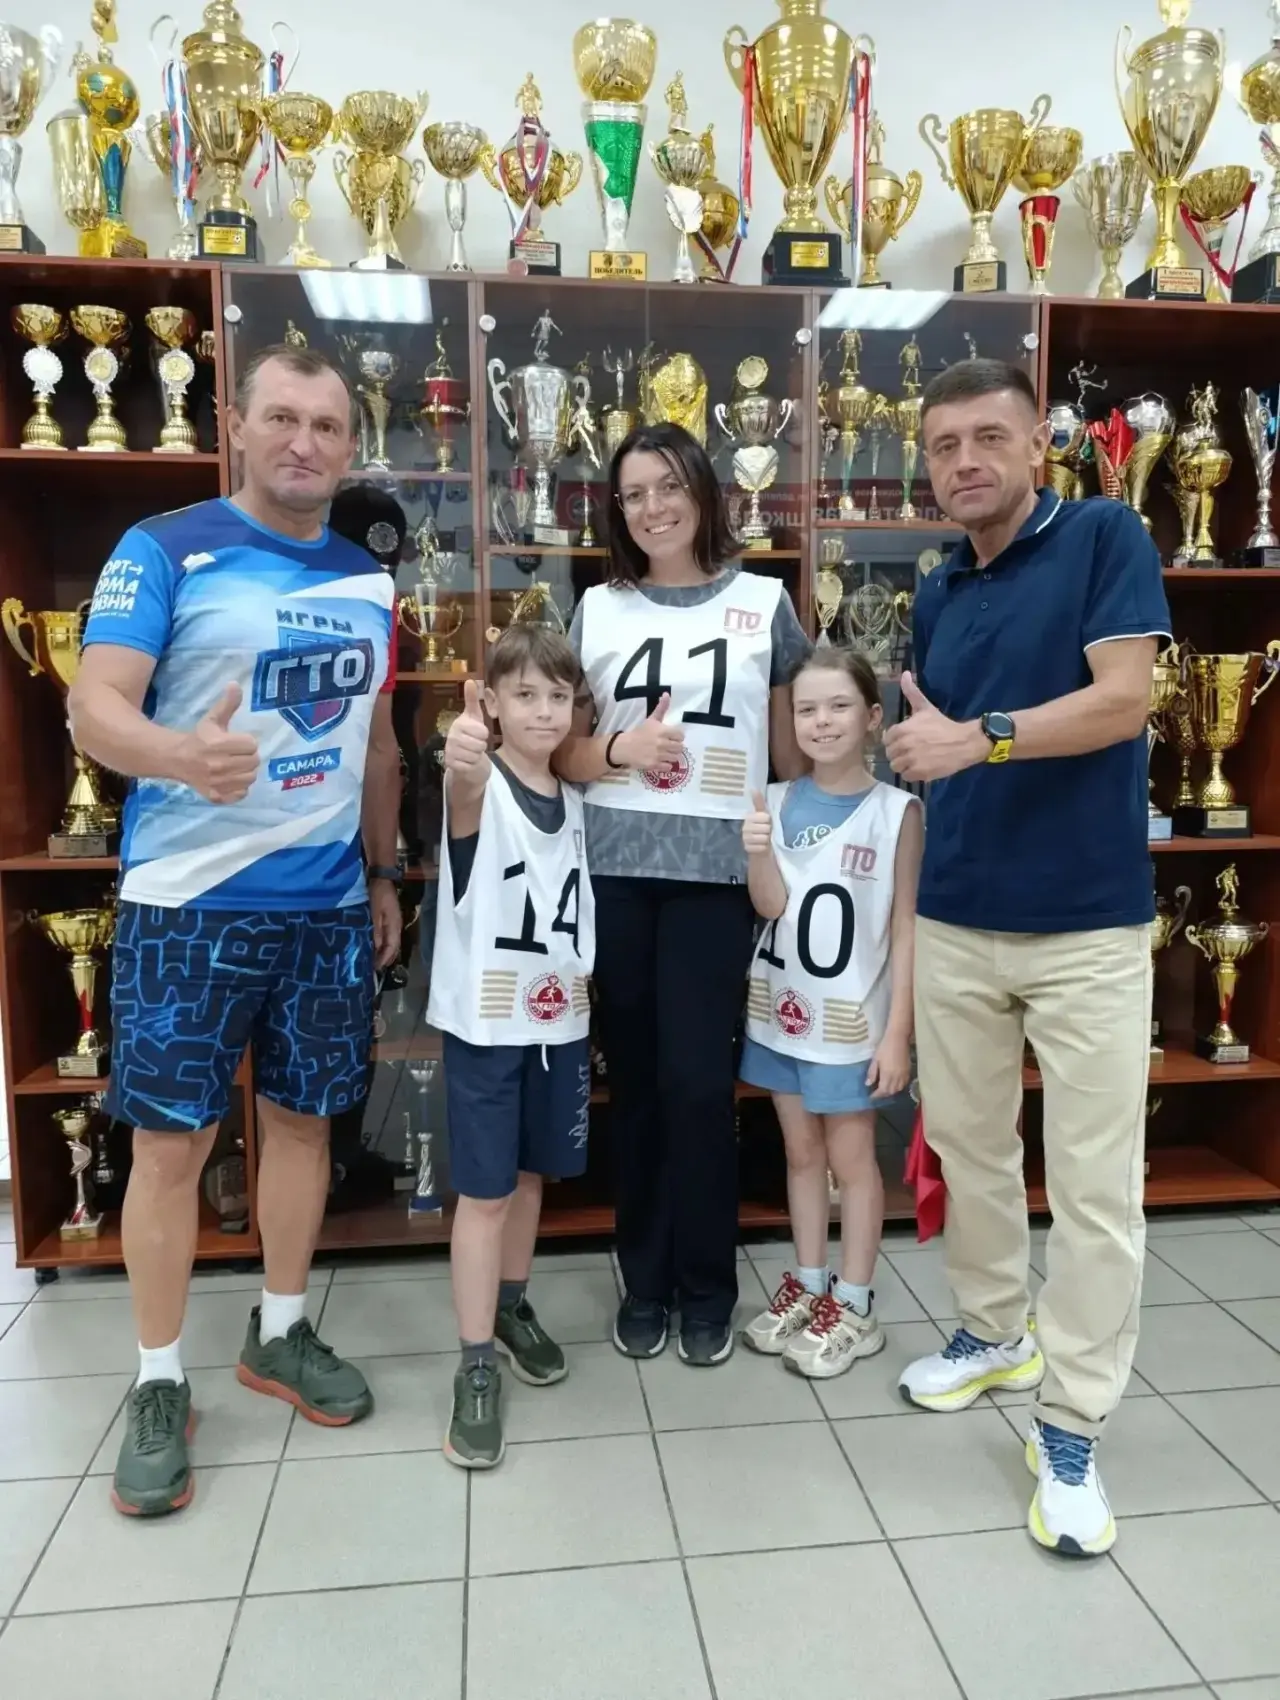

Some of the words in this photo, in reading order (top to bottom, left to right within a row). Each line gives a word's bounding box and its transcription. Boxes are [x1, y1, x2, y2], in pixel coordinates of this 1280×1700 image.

[275, 608, 354, 634] ИГРЫ
[265, 648, 367, 700] ГТО
[613, 637, 736, 729] 41
[276, 753, 336, 775] САМАРА
[289, 773, 319, 788] 2022
[494, 860, 582, 959] 14
